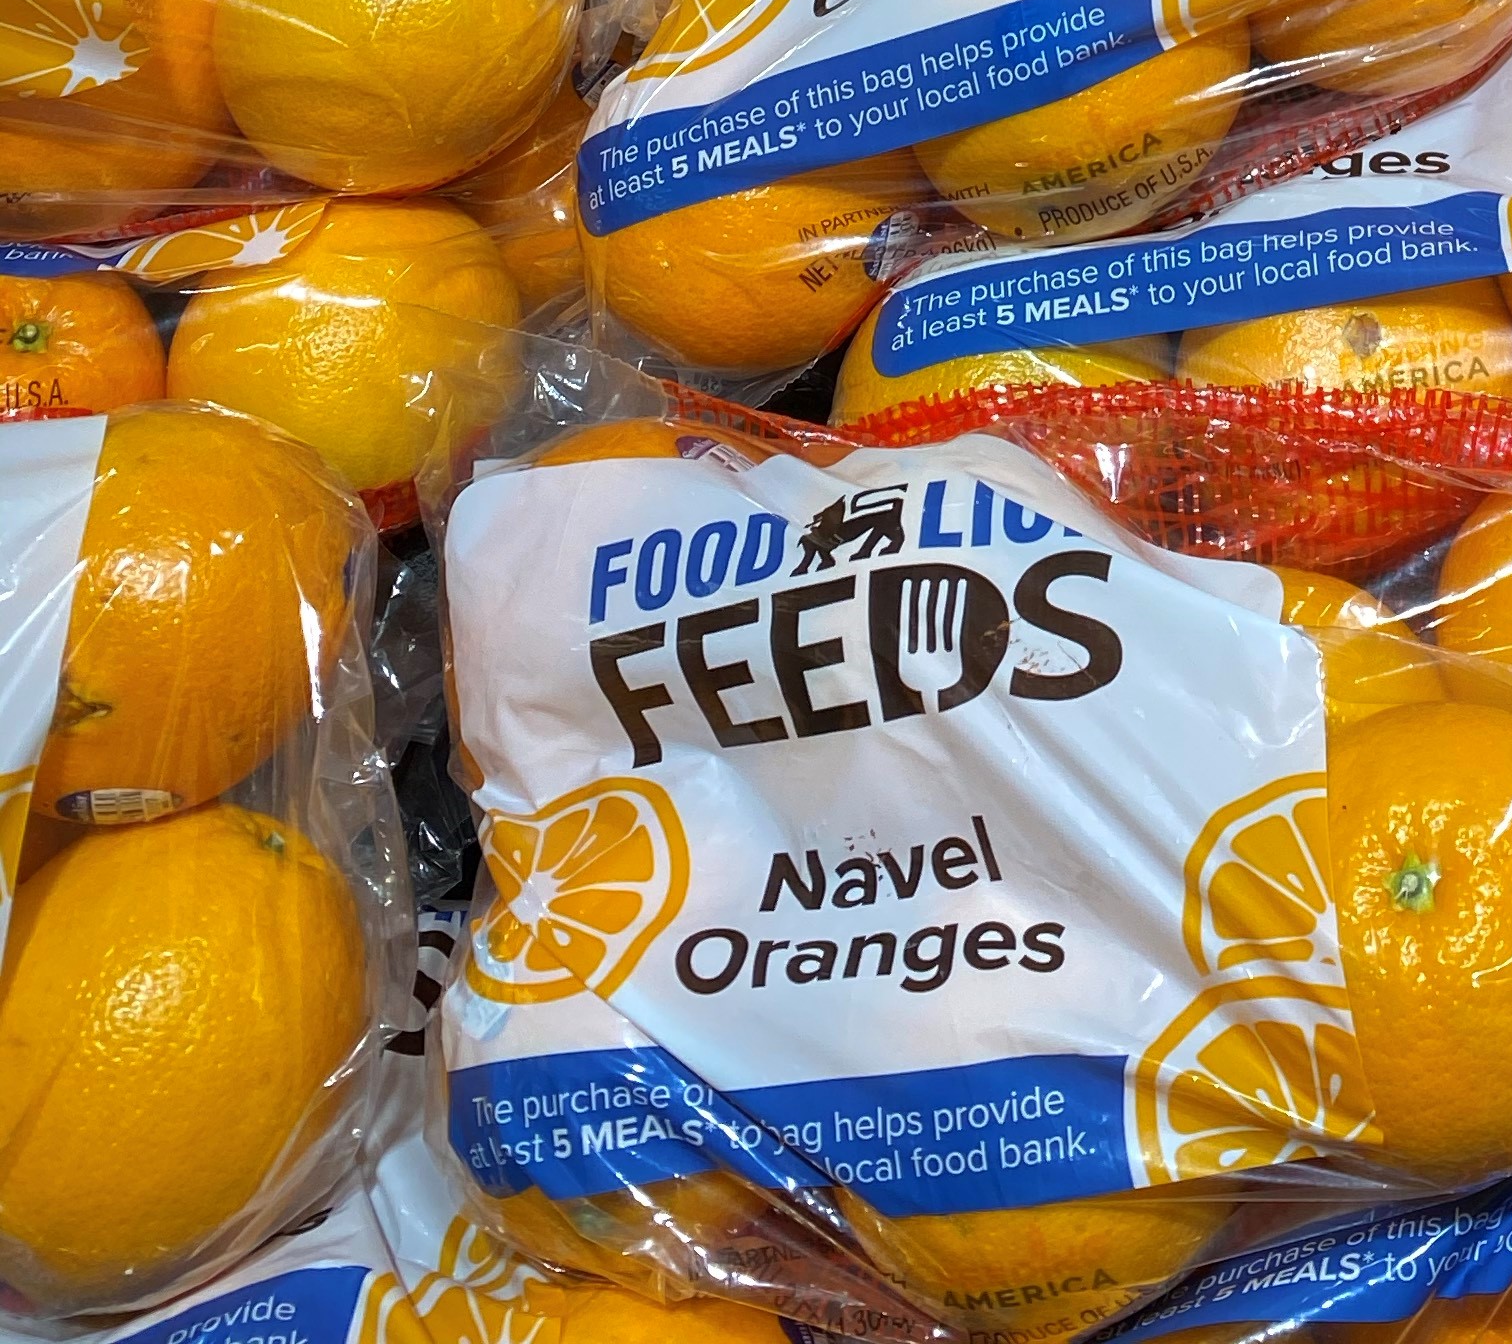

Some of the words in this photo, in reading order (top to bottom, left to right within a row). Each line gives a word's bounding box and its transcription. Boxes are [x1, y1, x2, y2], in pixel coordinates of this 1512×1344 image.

[589, 188, 606, 209] at
[607, 165, 665, 202] least
[672, 156, 687, 178] 5
[814, 117, 842, 141] to
[848, 100, 909, 139] your
[917, 75, 981, 113] local
[986, 56, 1049, 92] food
[1056, 33, 1133, 69] bank.
[599, 135, 653, 173] The
[646, 101, 765, 161] purchase
[775, 90, 803, 120] of
[807, 76, 854, 109] this
[862, 62, 914, 97] bag
[921, 41, 995, 76] helps
[1002, 5, 1105, 54] provide
[948, 183, 991, 204] WITH
[1021, 132, 1162, 196] AMERICA
[1039, 187, 1134, 234] PRODUCE
[1134, 175, 1159, 200] OF
[1161, 147, 1214, 189] U.S.A.
[891, 330, 914, 352] at
[921, 310, 986, 342] least
[997, 305, 1014, 324] 5
[1148, 283, 1175, 305] to
[1184, 276, 1247, 309] your
[1255, 257, 1318, 288] local
[1326, 246, 1393, 276] food
[1401, 237, 1478, 262] bank.
[913, 292, 960, 316] The
[971, 268, 1097, 303] purchase
[1107, 252, 1135, 279] of
[1141, 244, 1191, 275] this
[1200, 237, 1253, 264] bag
[1262, 224, 1338, 254] helps
[1347, 218, 1455, 243] provide
[588, 514, 789, 625] FOOD
[919, 479, 1082, 548] LIO
[590, 551, 1121, 767] FEEDS
[759, 816, 1003, 914] Navel
[675, 914, 1066, 996] Oranges
[523, 1085, 669, 1127] purchase
[834, 1105, 922, 1147] helps
[933, 1086, 1065, 1136] provide
[554, 1133, 572, 1157] 5
[827, 1149, 901, 1185] local
[911, 1139, 989, 1179] food
[999, 1127, 1096, 1169] bank.
[943, 1268, 1119, 1312] AMERICA
